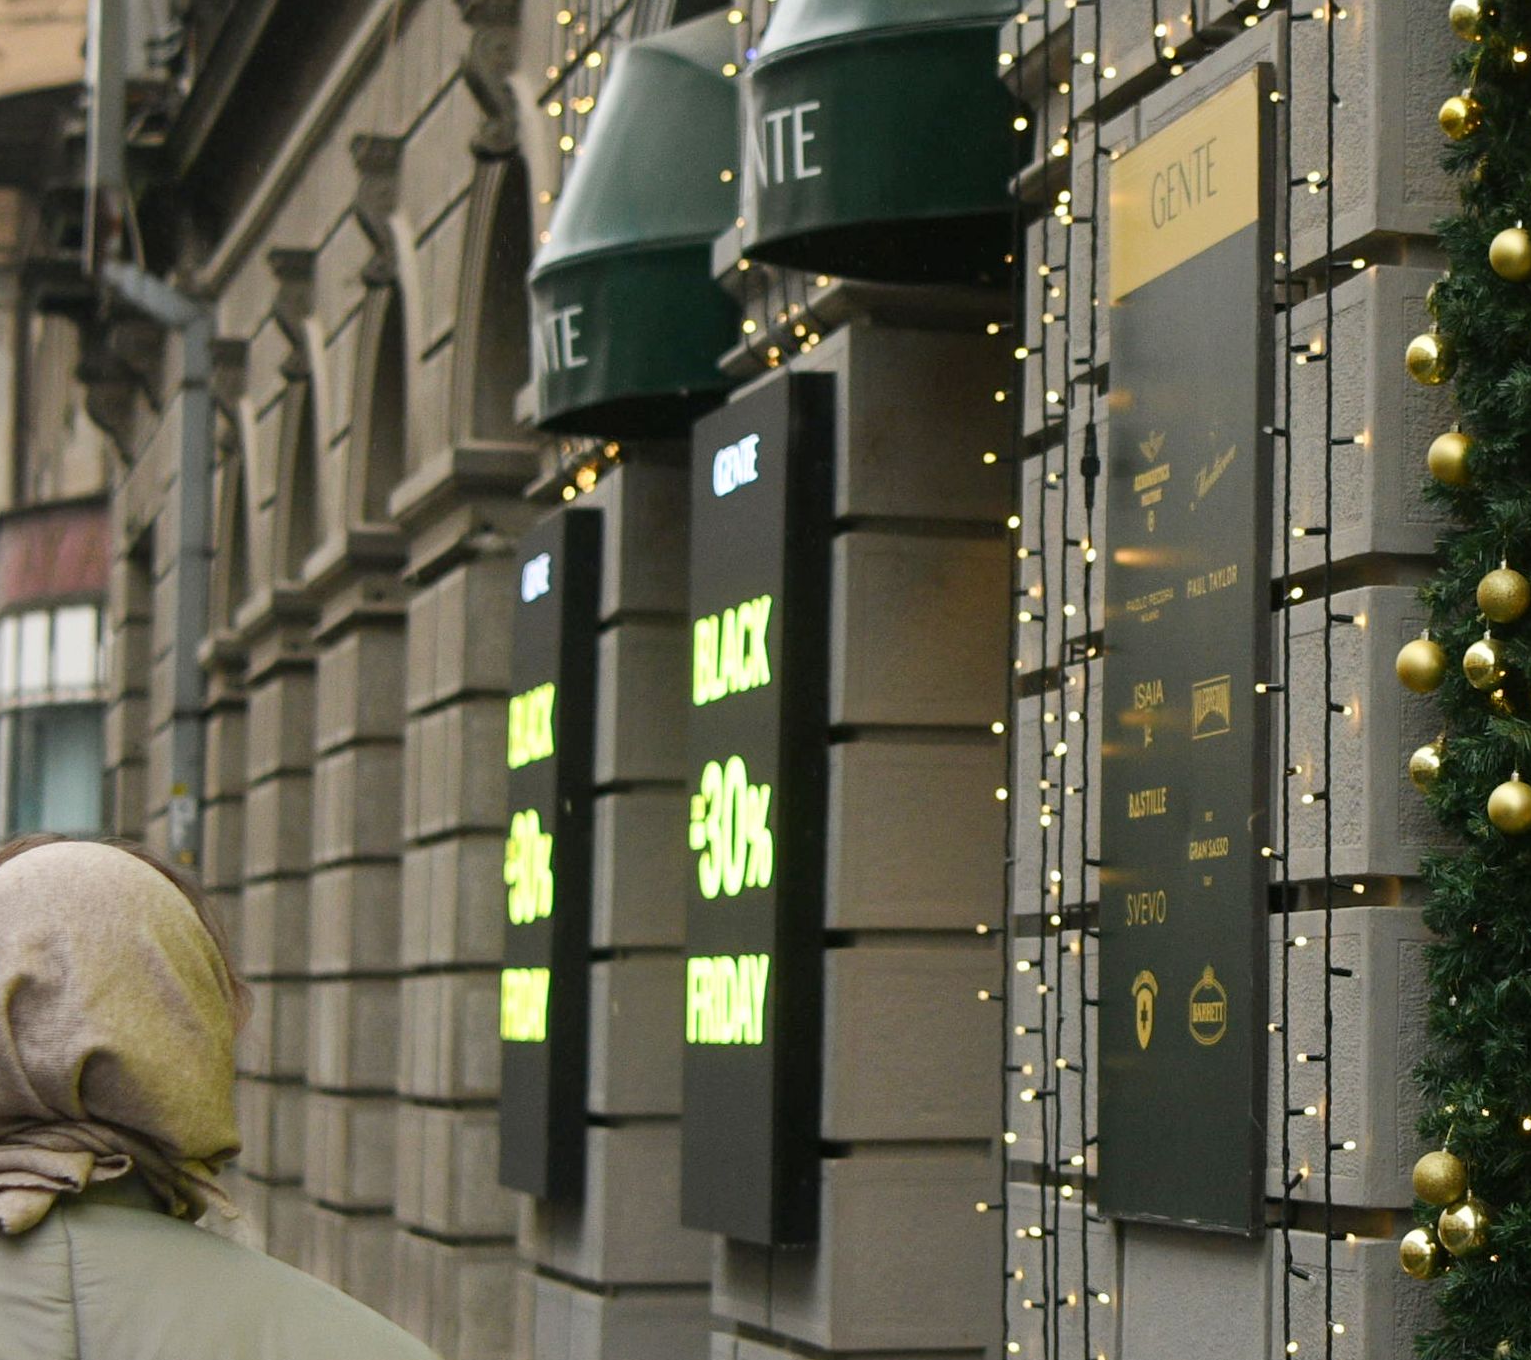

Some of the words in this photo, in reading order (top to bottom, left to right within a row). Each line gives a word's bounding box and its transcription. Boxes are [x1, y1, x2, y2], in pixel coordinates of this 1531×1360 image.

[1150, 136, 1218, 230] GENTE
[713, 433, 760, 497] GENTE
[1187, 576, 1207, 598] PAUL
[1209, 564, 1238, 592] TAYLOR
[692, 594, 772, 706] BLACK
[1134, 679, 1164, 710] ISAIA
[1129, 787, 1167, 818] BASTILLE
[1126, 890, 1166, 926] SVEVO
[686, 953, 770, 1045] FRIDAY
